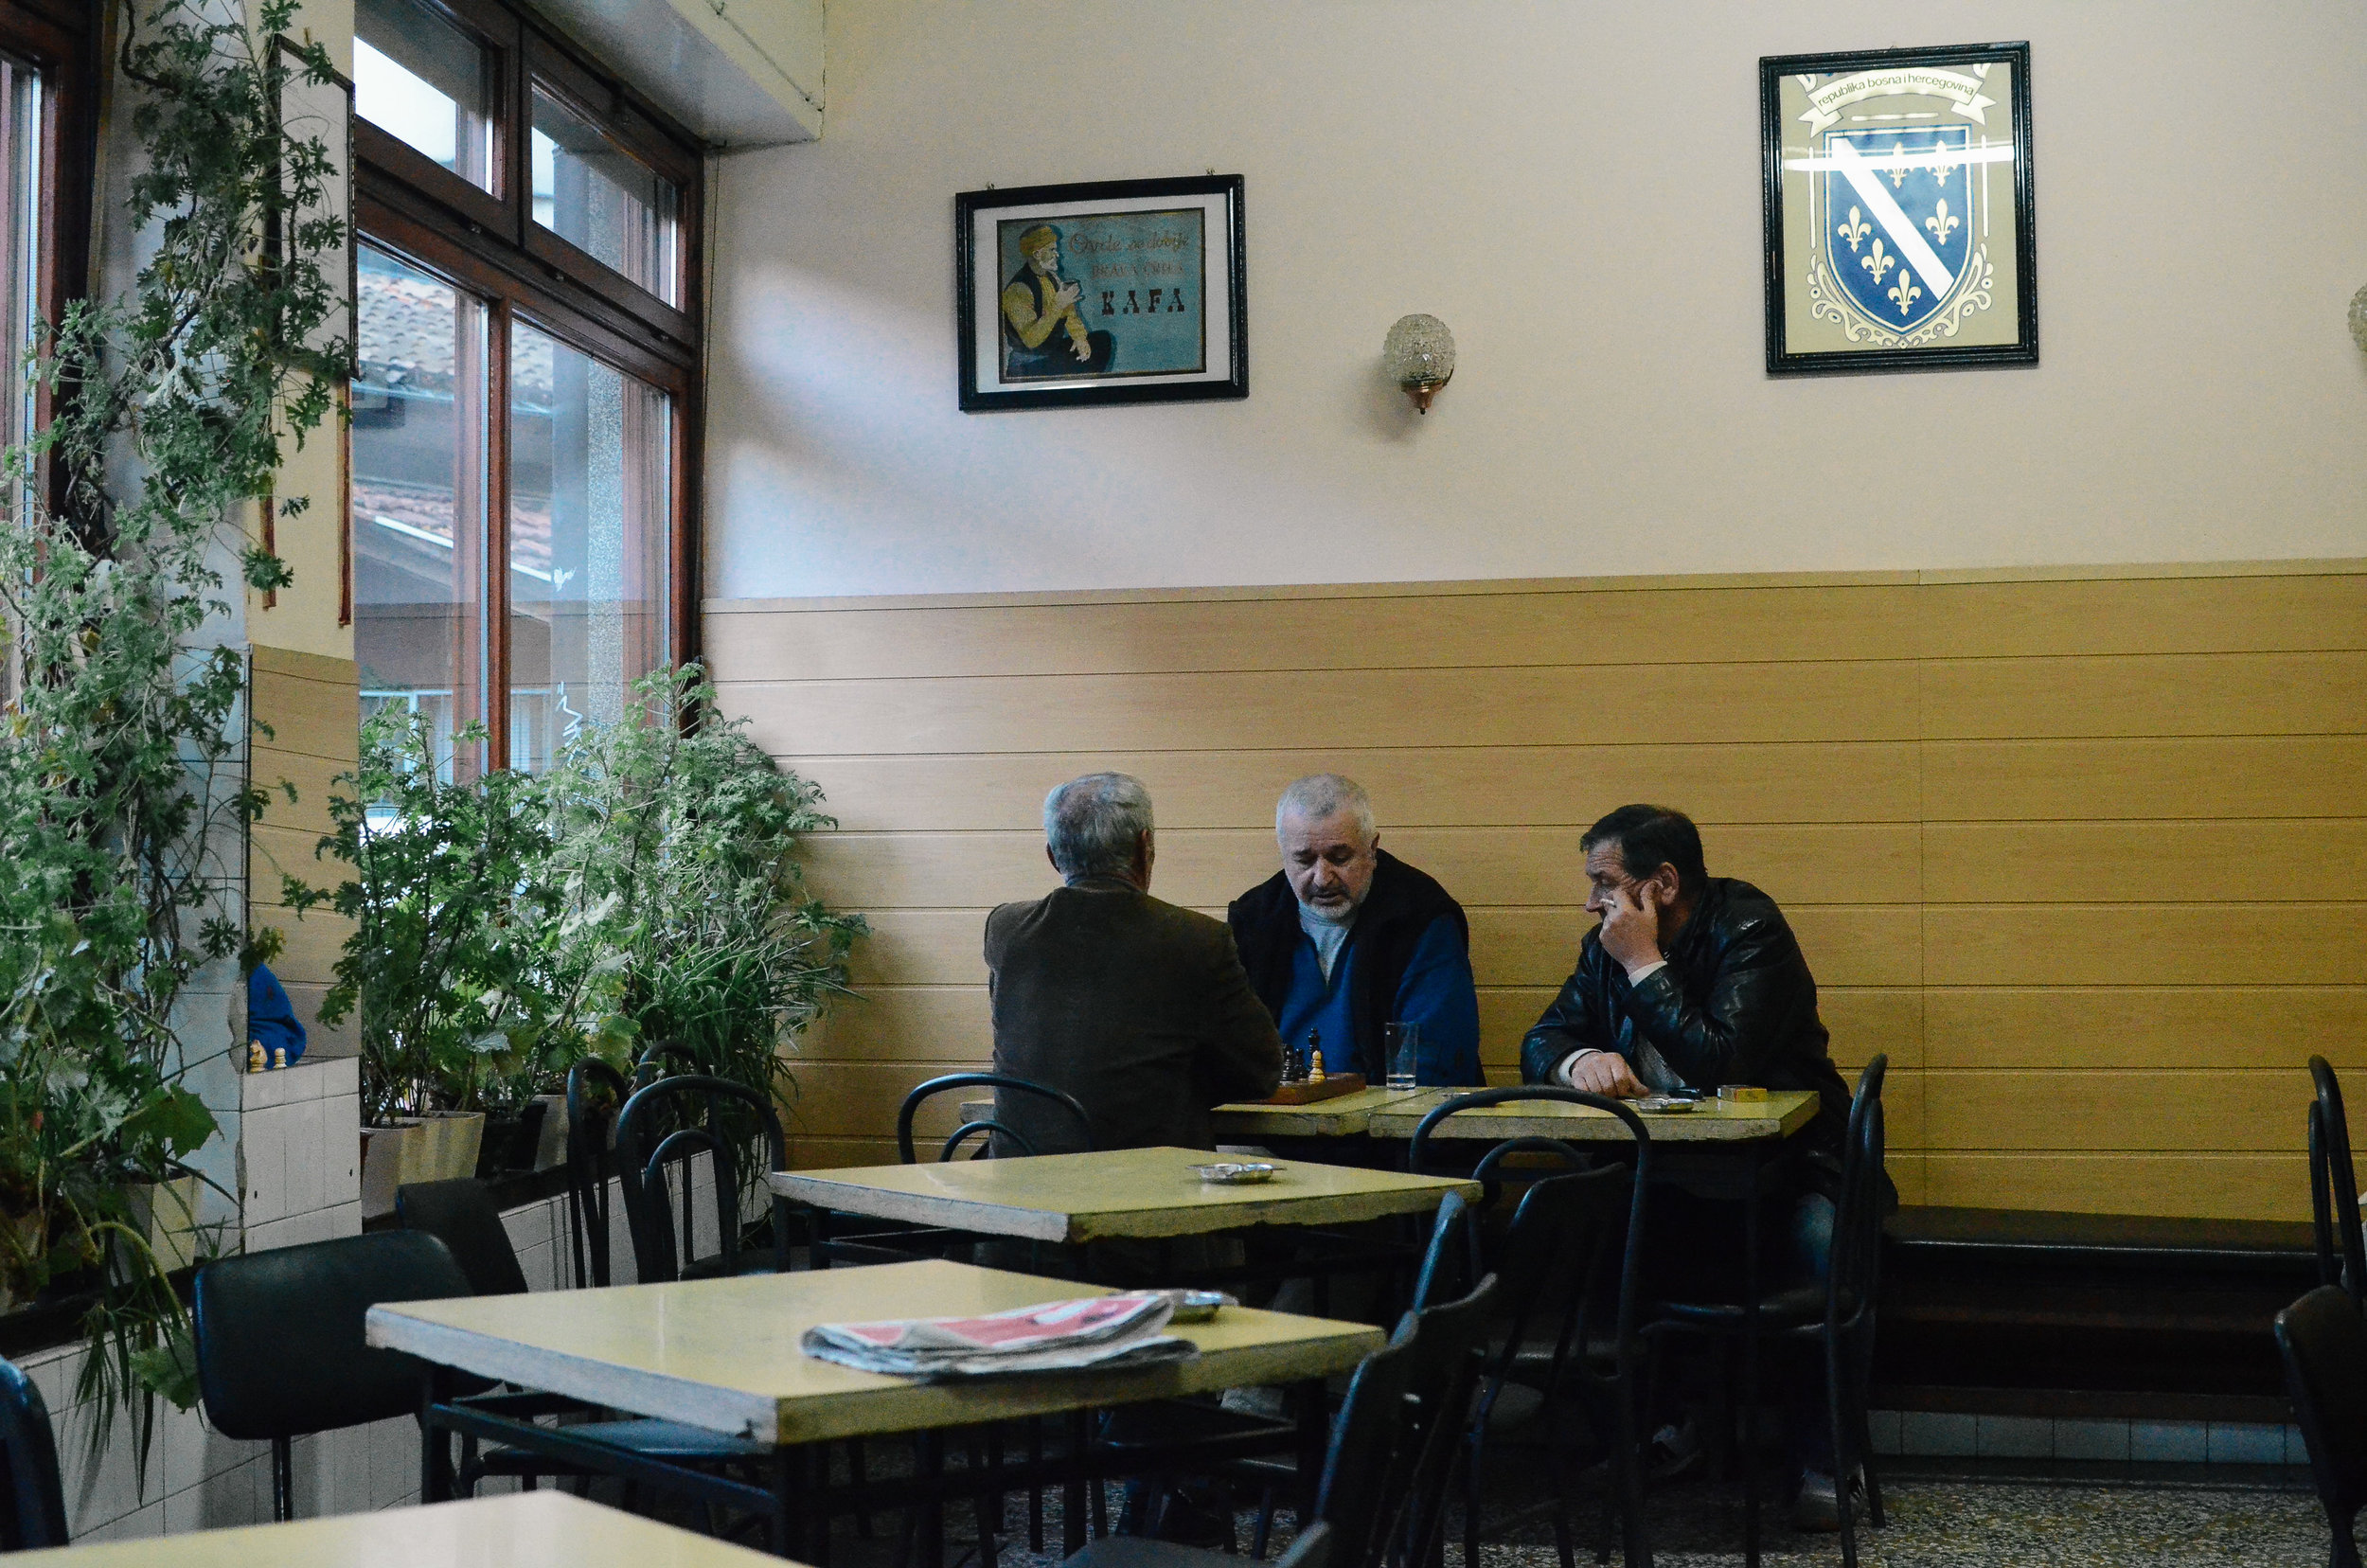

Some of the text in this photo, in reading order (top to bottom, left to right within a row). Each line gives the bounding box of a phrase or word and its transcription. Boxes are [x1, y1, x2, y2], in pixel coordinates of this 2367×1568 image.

[1817, 80, 1866, 106] republika
[1867, 74, 1902, 89] bosna
[1909, 73, 1975, 96] hercegovina
[1101, 288, 1185, 315] KAFA
